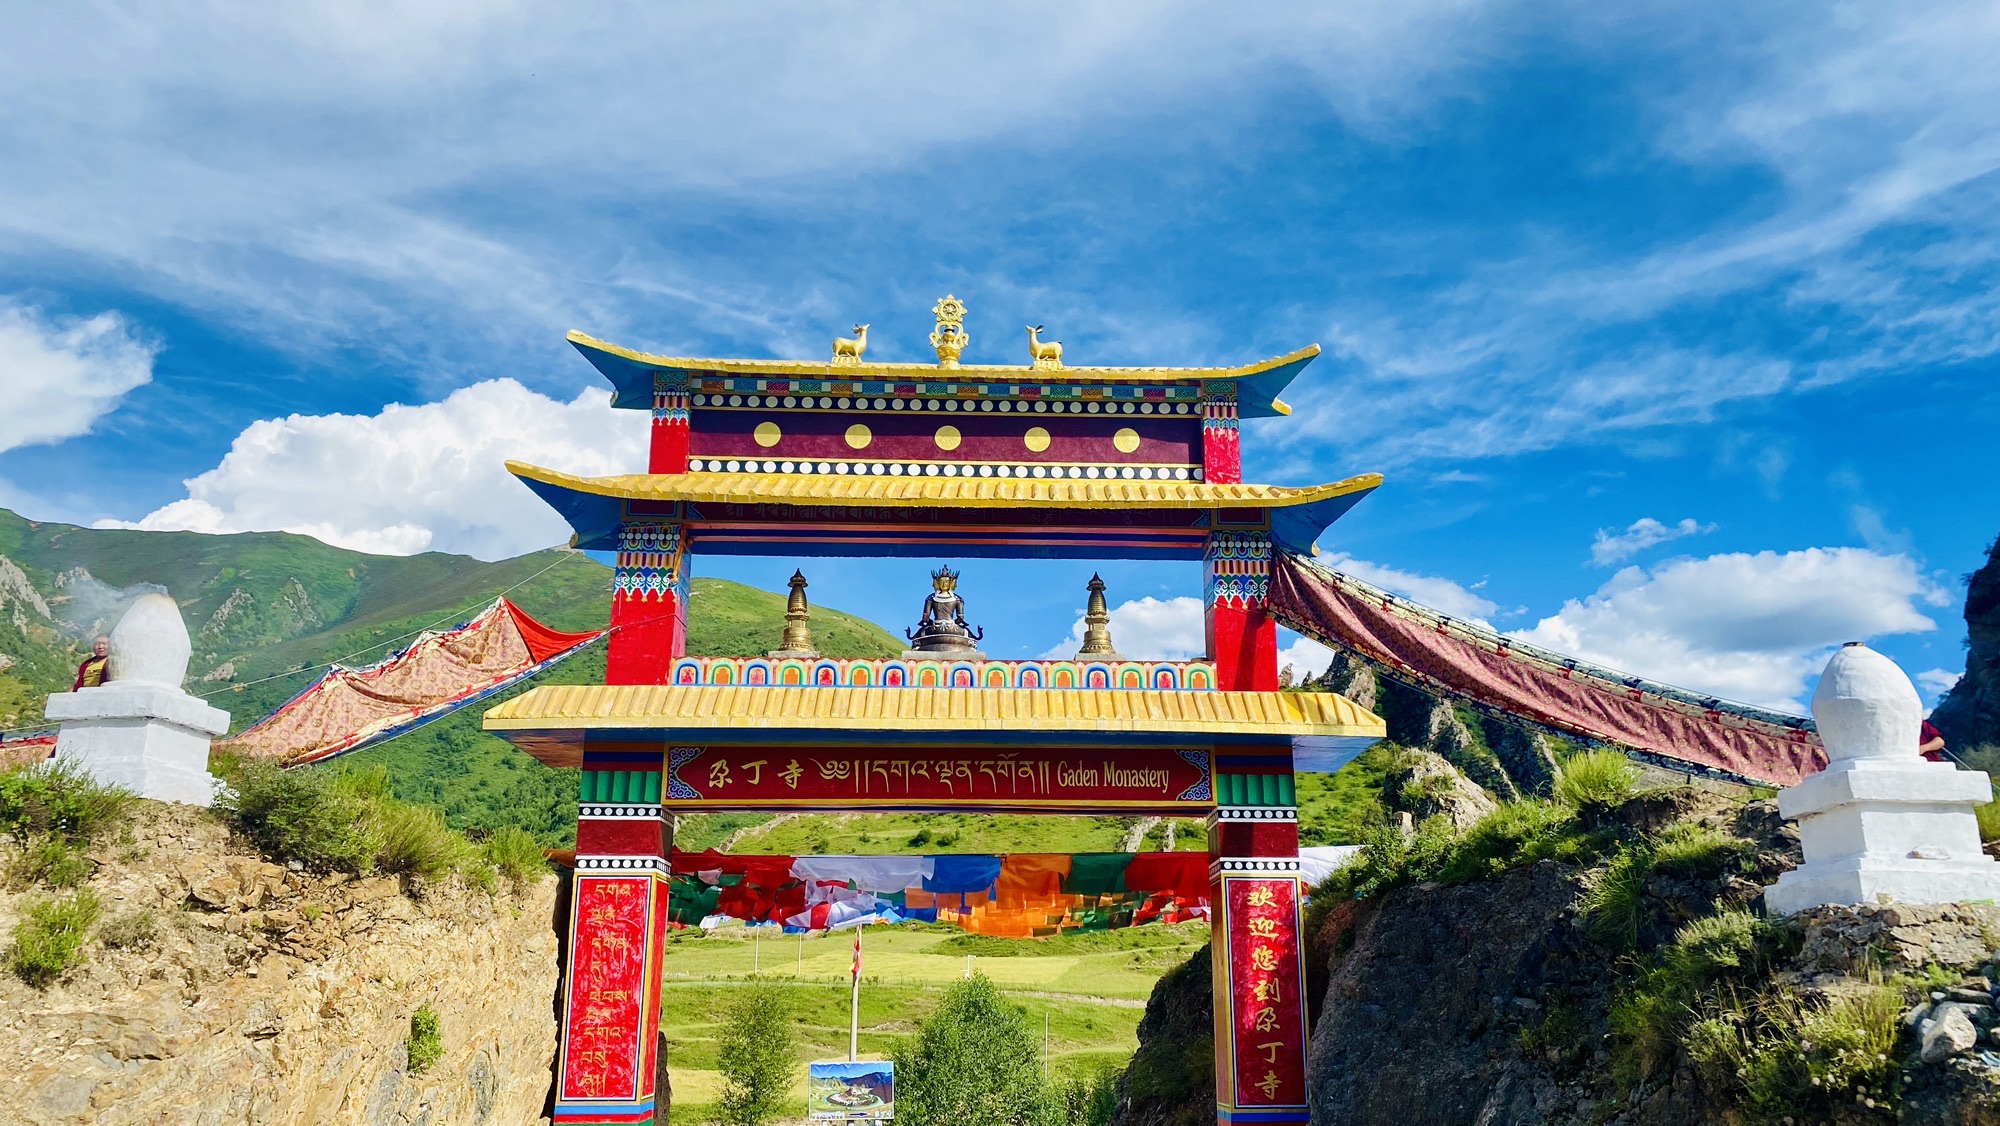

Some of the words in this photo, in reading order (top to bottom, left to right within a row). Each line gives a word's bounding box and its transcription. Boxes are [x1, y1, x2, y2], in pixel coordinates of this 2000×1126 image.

[708, 758, 805, 790] 尕丁寺
[1056, 760, 1099, 788] Gaden
[1103, 760, 1170, 794] Monastery
[1246, 885, 1284, 1101] 欢迎您到尕丁寺
